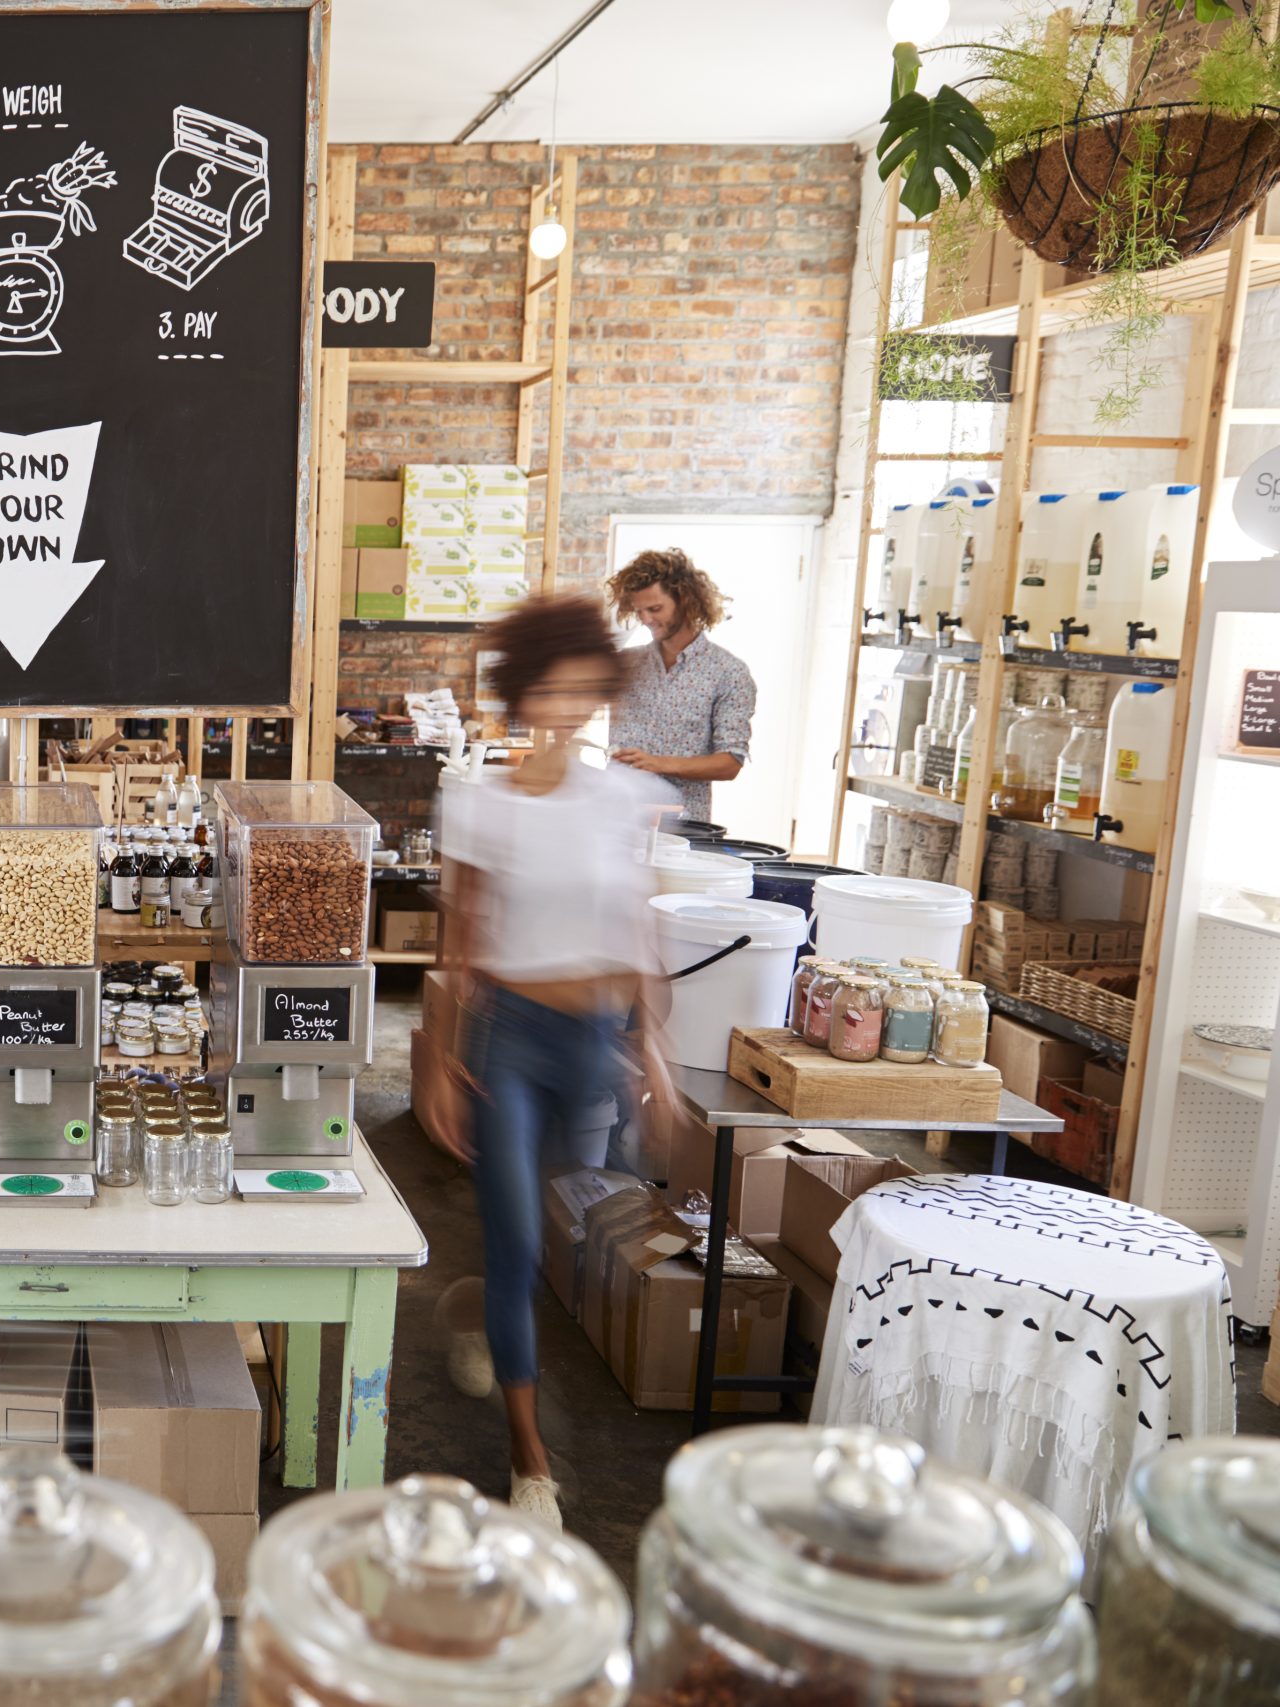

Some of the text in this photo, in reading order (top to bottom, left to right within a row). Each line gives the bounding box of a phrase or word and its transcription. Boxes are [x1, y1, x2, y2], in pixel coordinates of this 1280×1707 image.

[3, 84, 62, 117] WEIGH
[321, 286, 406, 324] ODY
[158, 310, 218, 340] 3. PAY
[275, 993, 330, 1011] Almond
[20, 1021, 66, 1033] Butter
[290, 1014, 339, 1028] Butter
